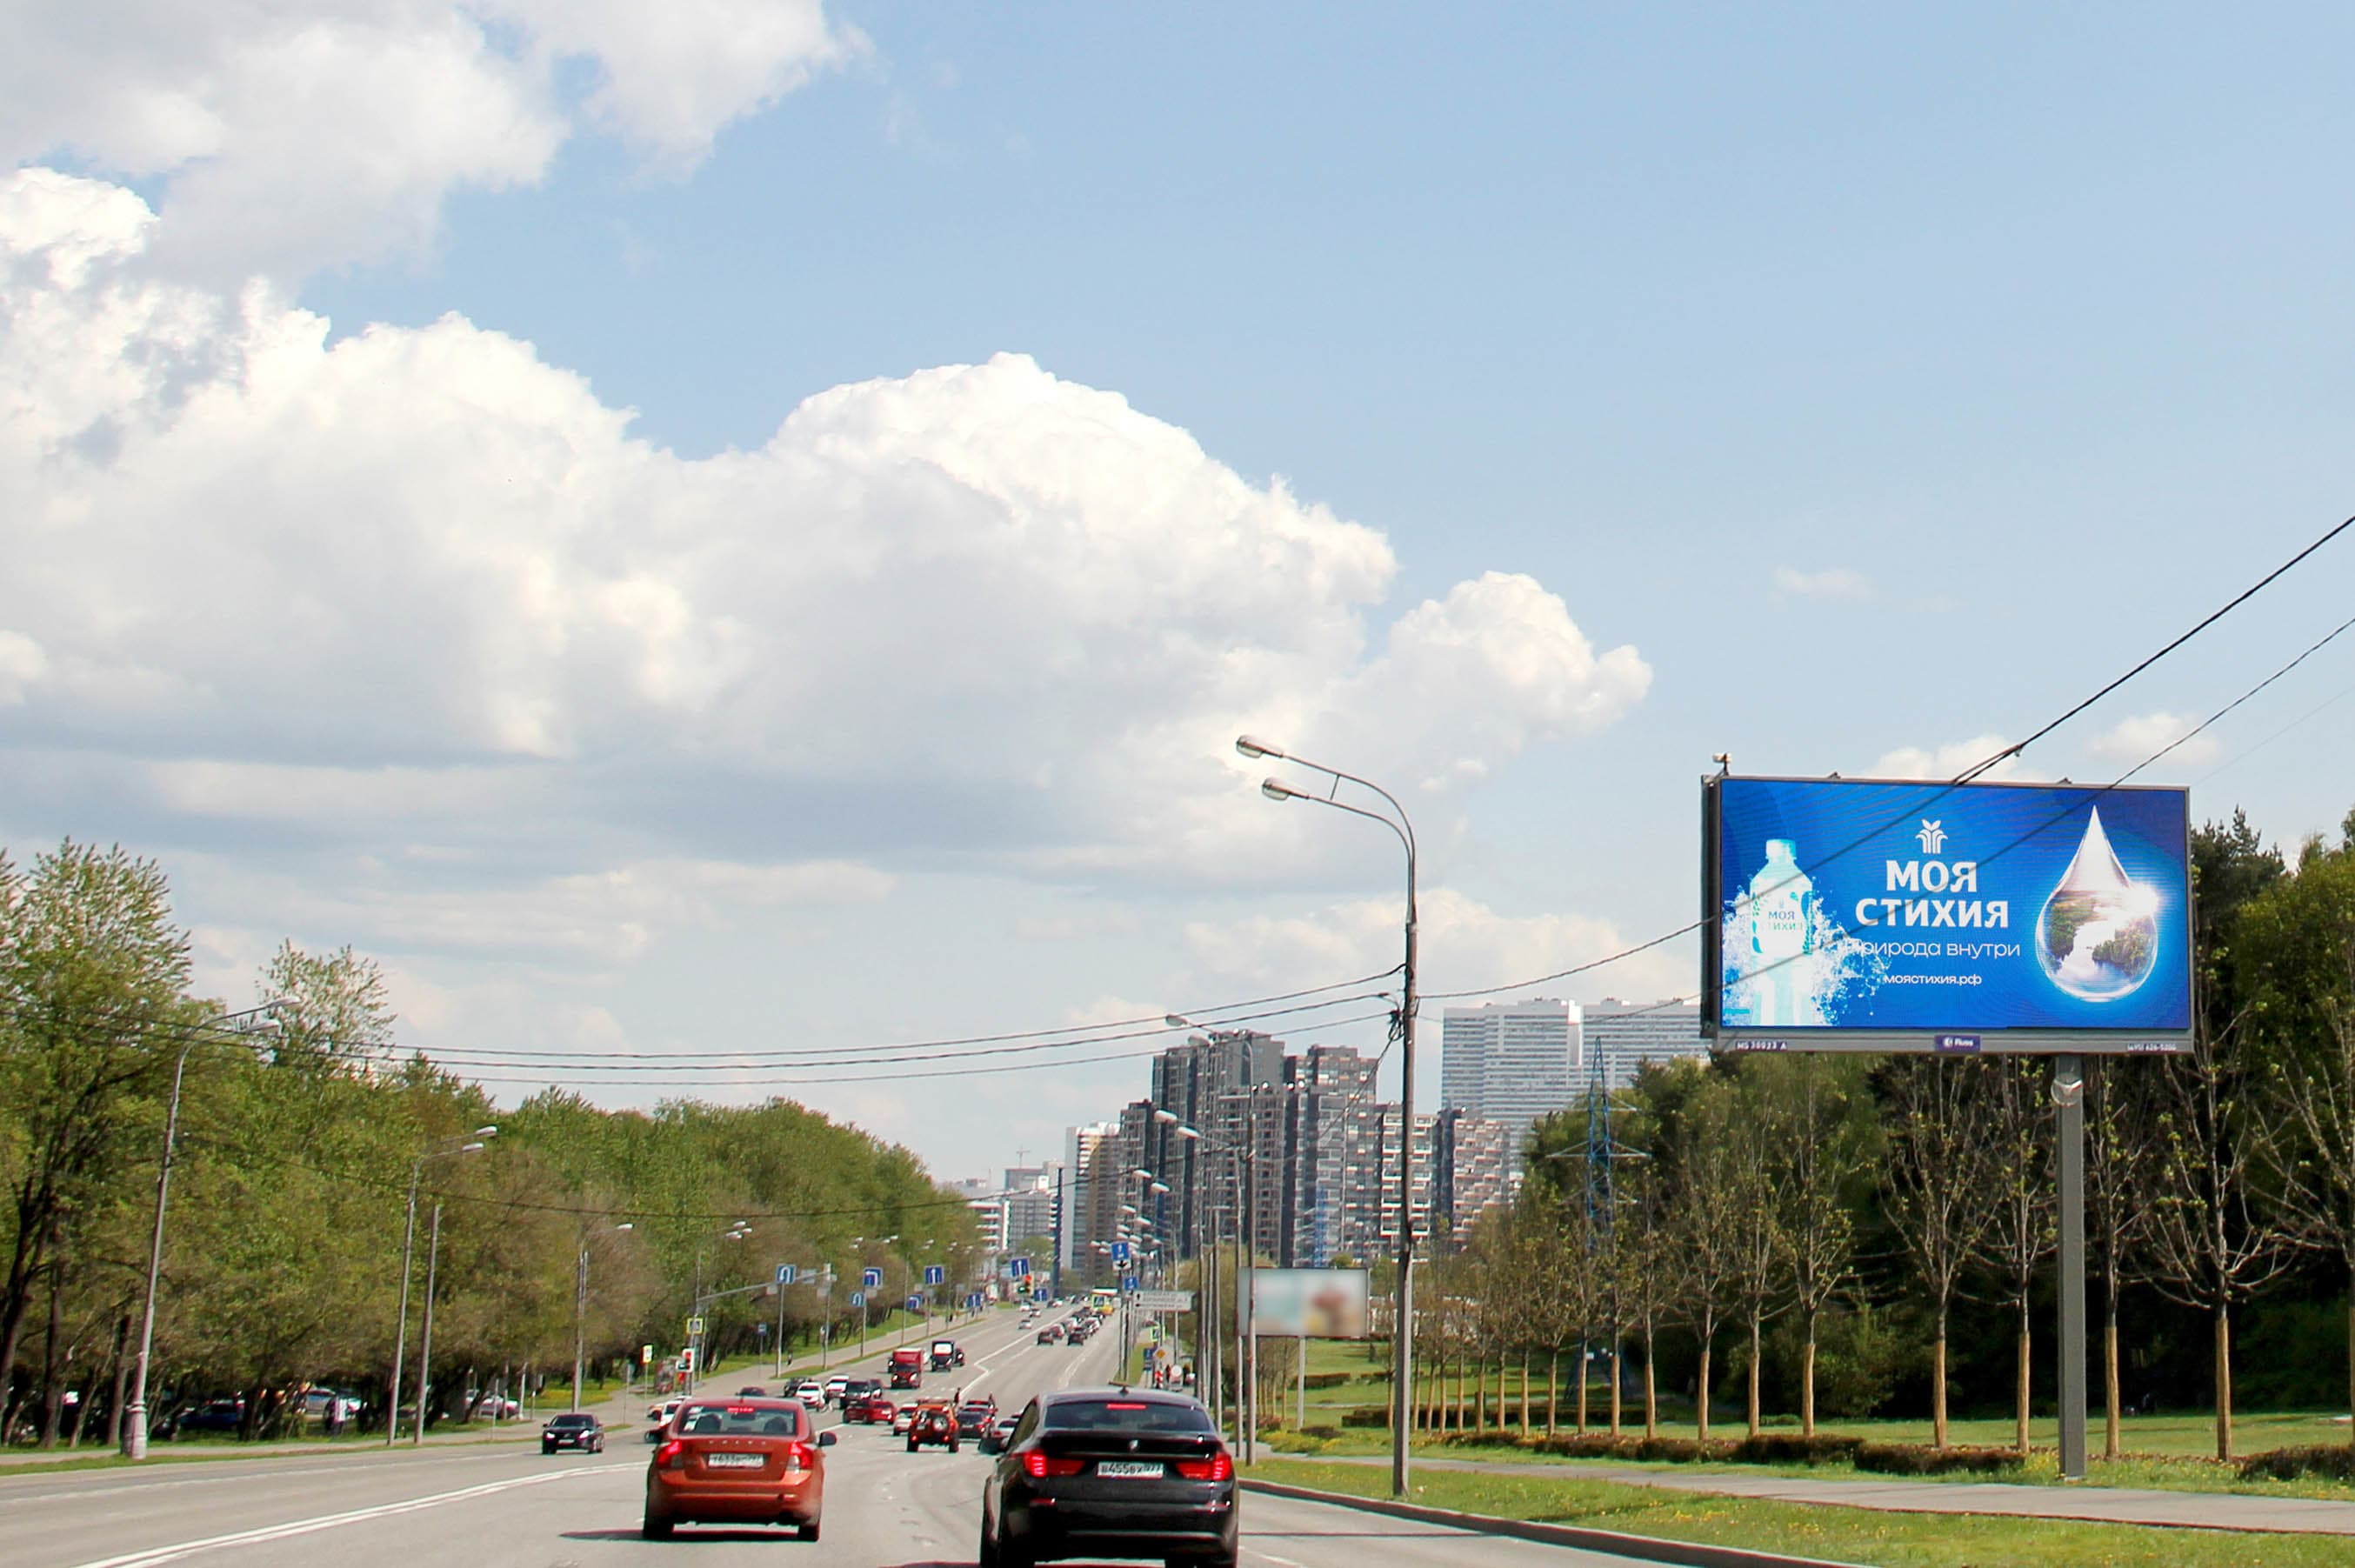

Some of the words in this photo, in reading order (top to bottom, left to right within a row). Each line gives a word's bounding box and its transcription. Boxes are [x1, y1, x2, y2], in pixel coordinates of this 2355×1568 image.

[1885, 859, 1978, 893] МОЯ
[1768, 911, 1795, 920] МОЯ
[1855, 897, 2010, 929] СТИХИЯ
[1946, 942, 2021, 959] внутри
[1885, 973, 1983, 986] моястихия.рф
